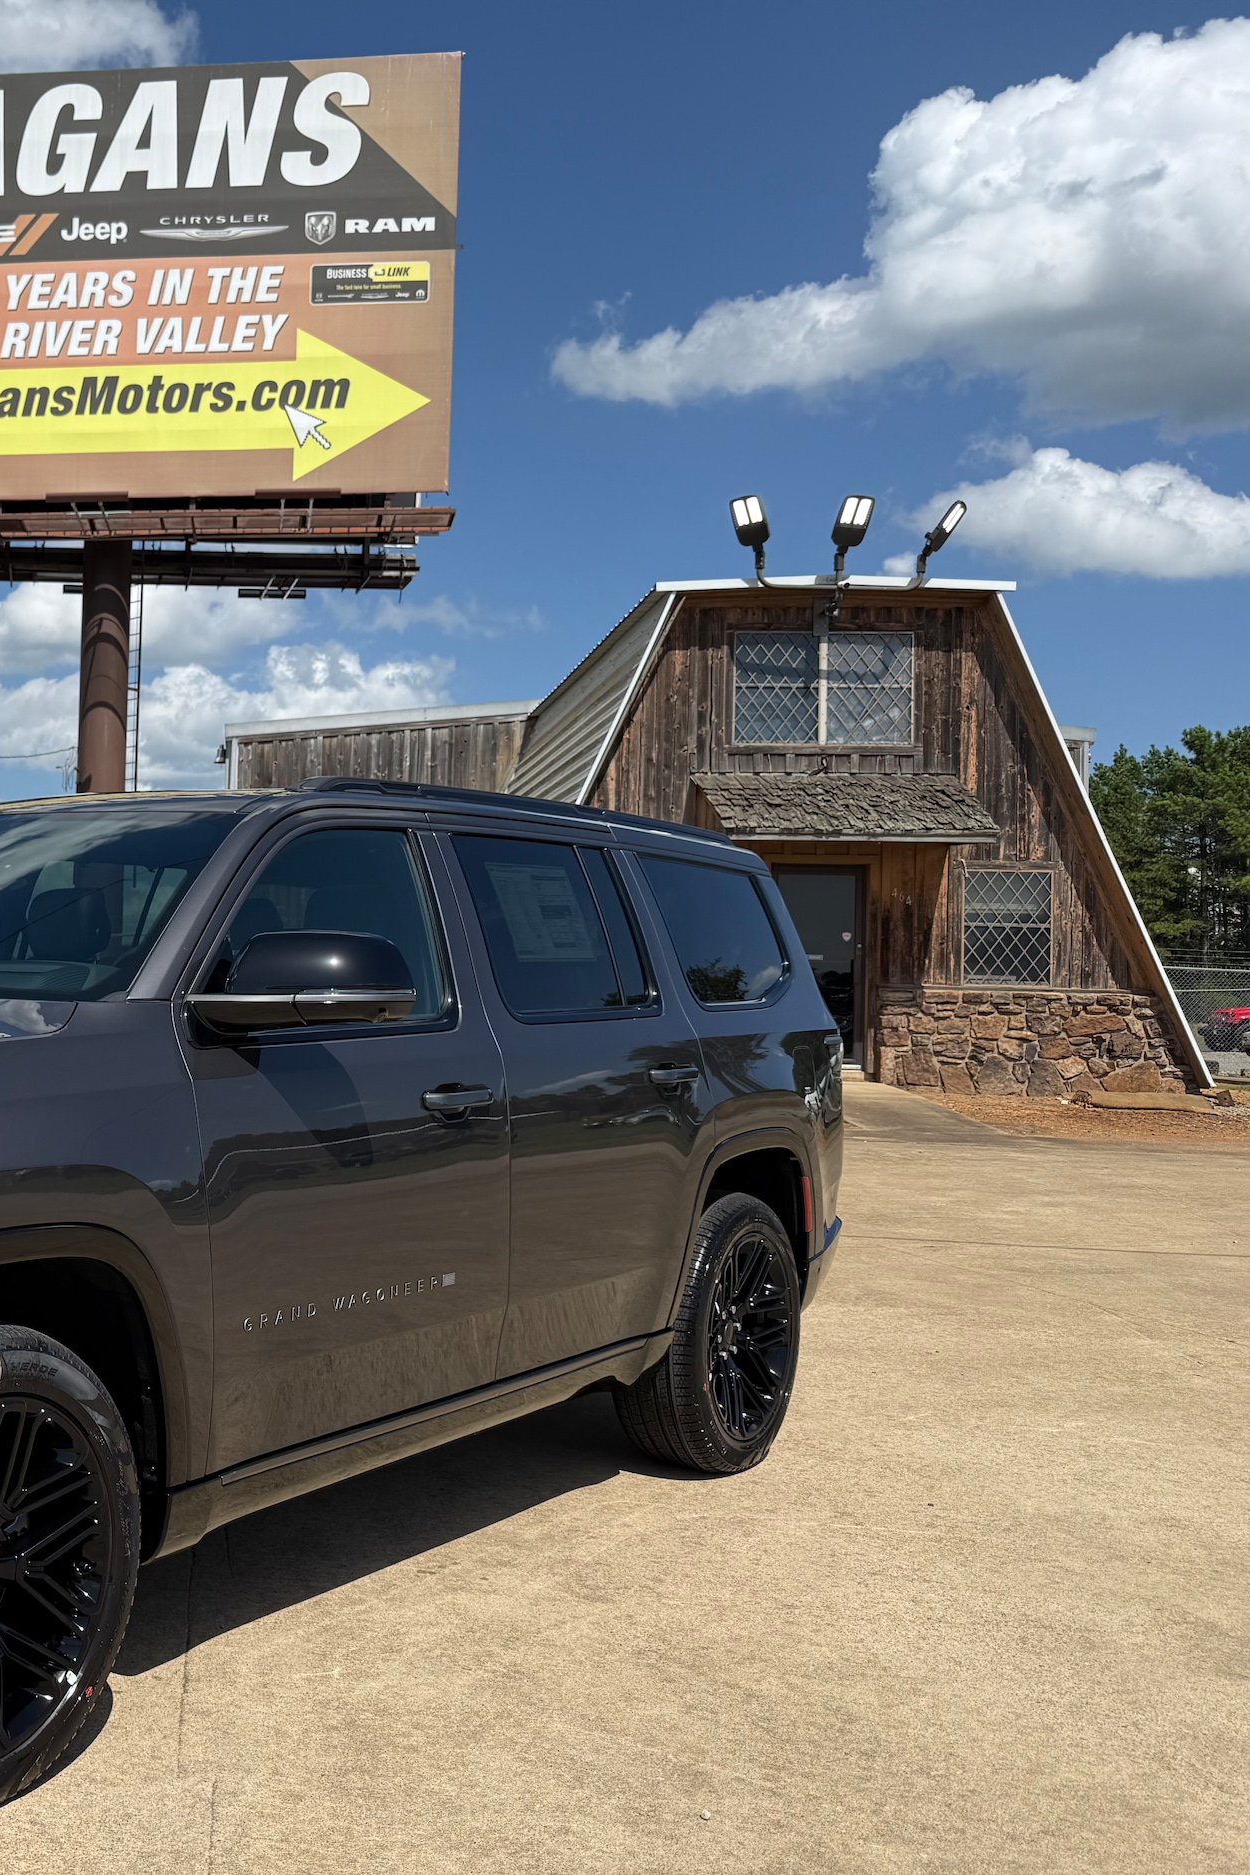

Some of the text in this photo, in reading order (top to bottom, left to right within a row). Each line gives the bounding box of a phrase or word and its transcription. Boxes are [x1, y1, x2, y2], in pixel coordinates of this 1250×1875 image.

[61, 217, 129, 245] Jeep
[159, 213, 270, 226] CHRYSLER
[344, 216, 437, 235] RAM
[326, 266, 411, 279] BUSINESS LINK
[5, 265, 286, 311] YEARS IN THE
[0, 313, 289, 359] RIVER VALLEY
[891, 887, 912, 906] 464
[242, 1275, 439, 1333] GRAND WAGONEER
